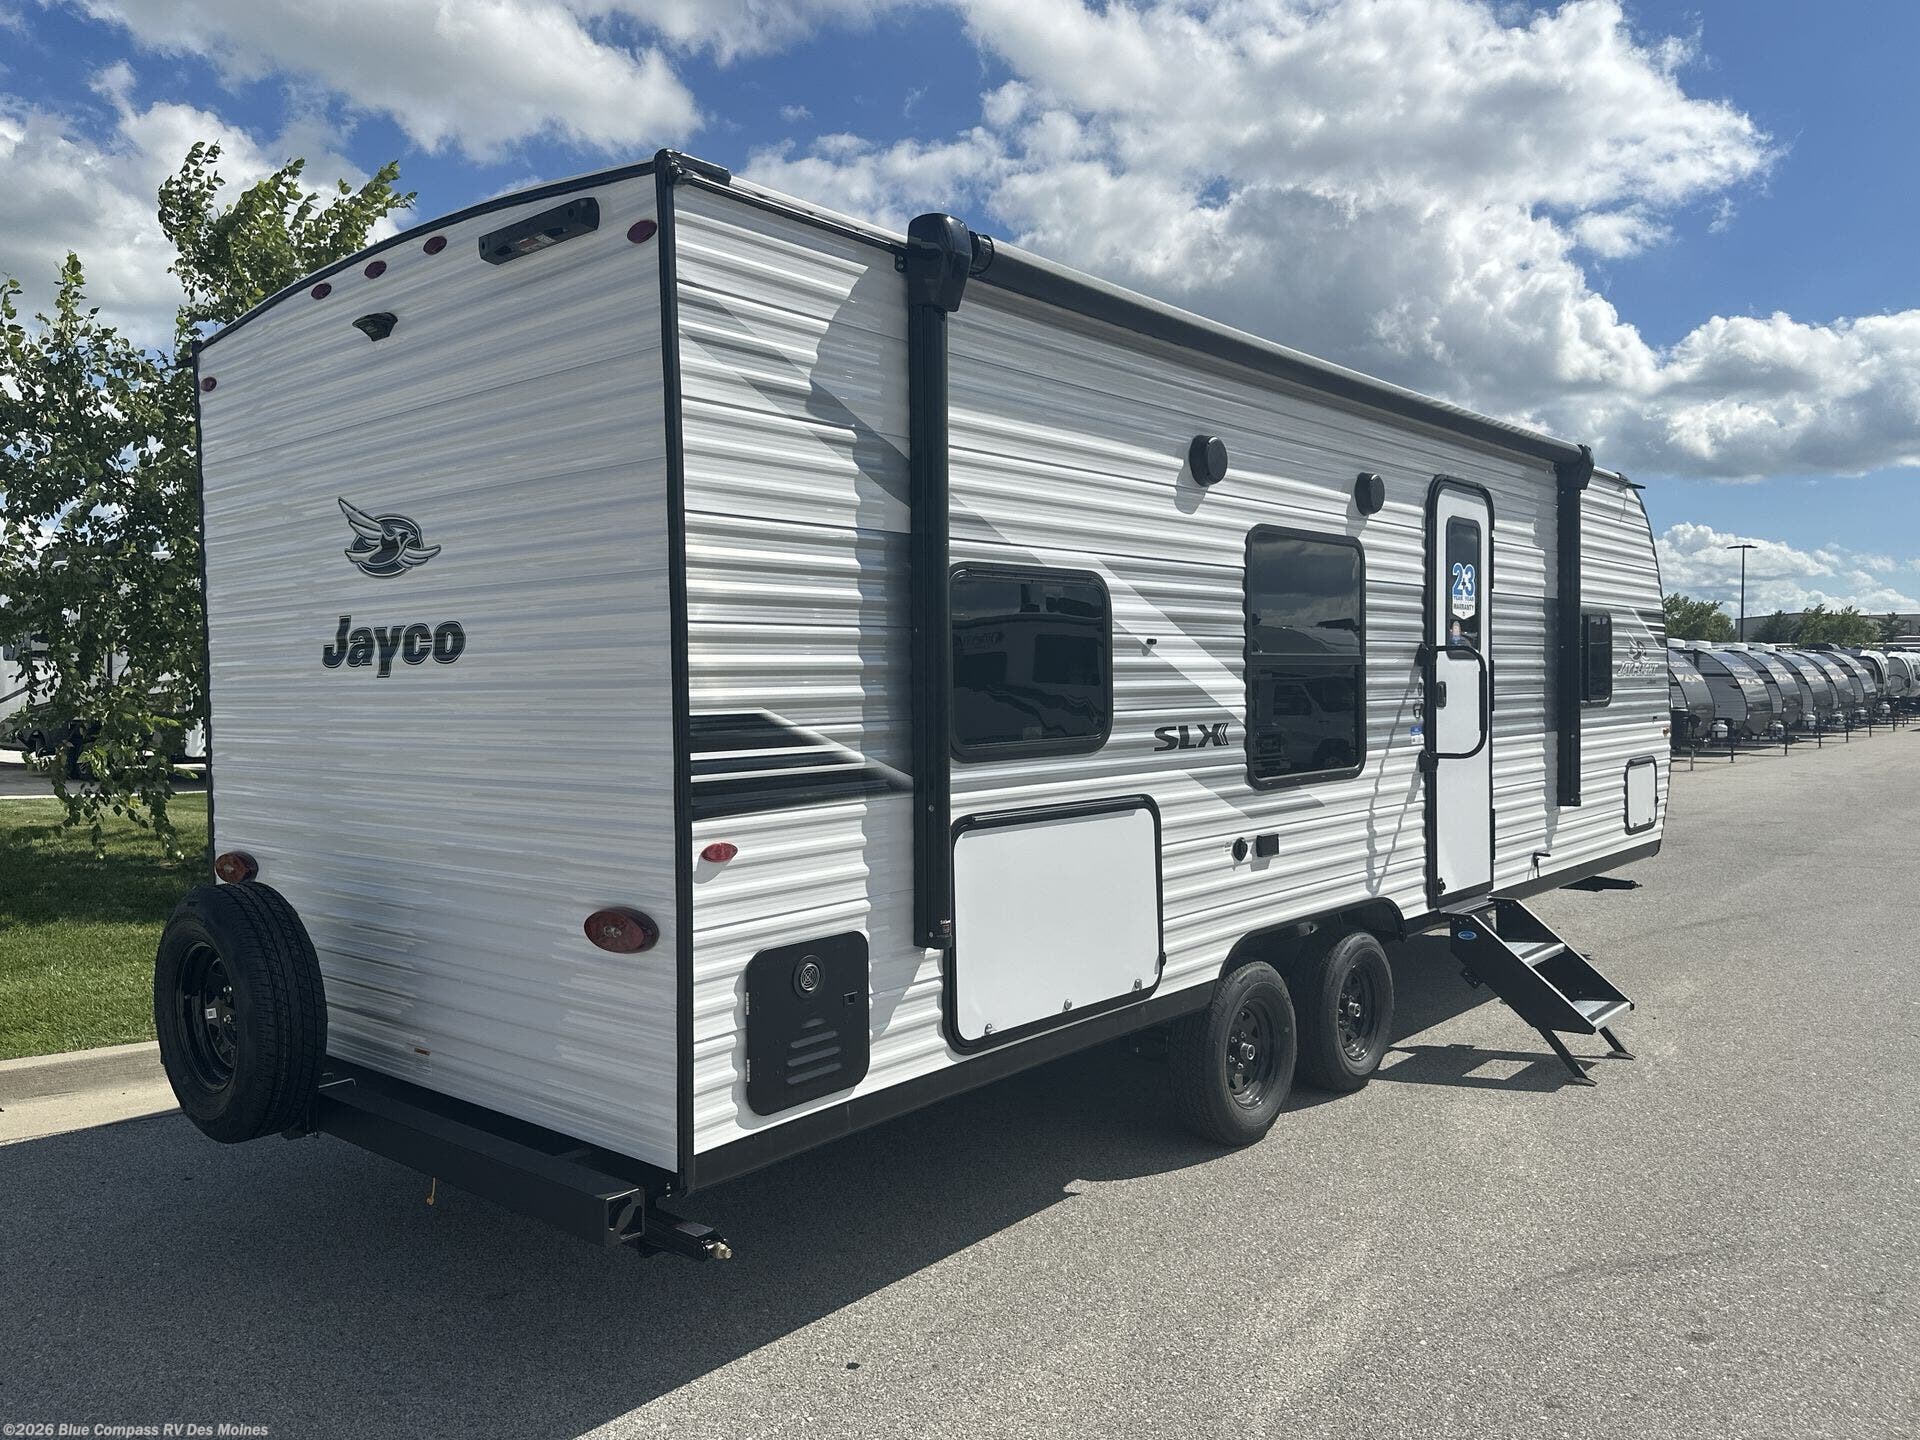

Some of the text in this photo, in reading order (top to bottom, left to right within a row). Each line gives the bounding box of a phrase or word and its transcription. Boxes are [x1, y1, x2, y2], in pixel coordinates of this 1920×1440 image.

[1453, 603, 1474, 611] WARRANTY
[322, 615, 466, 678] Jayco
[1154, 723, 1229, 751] SLX
